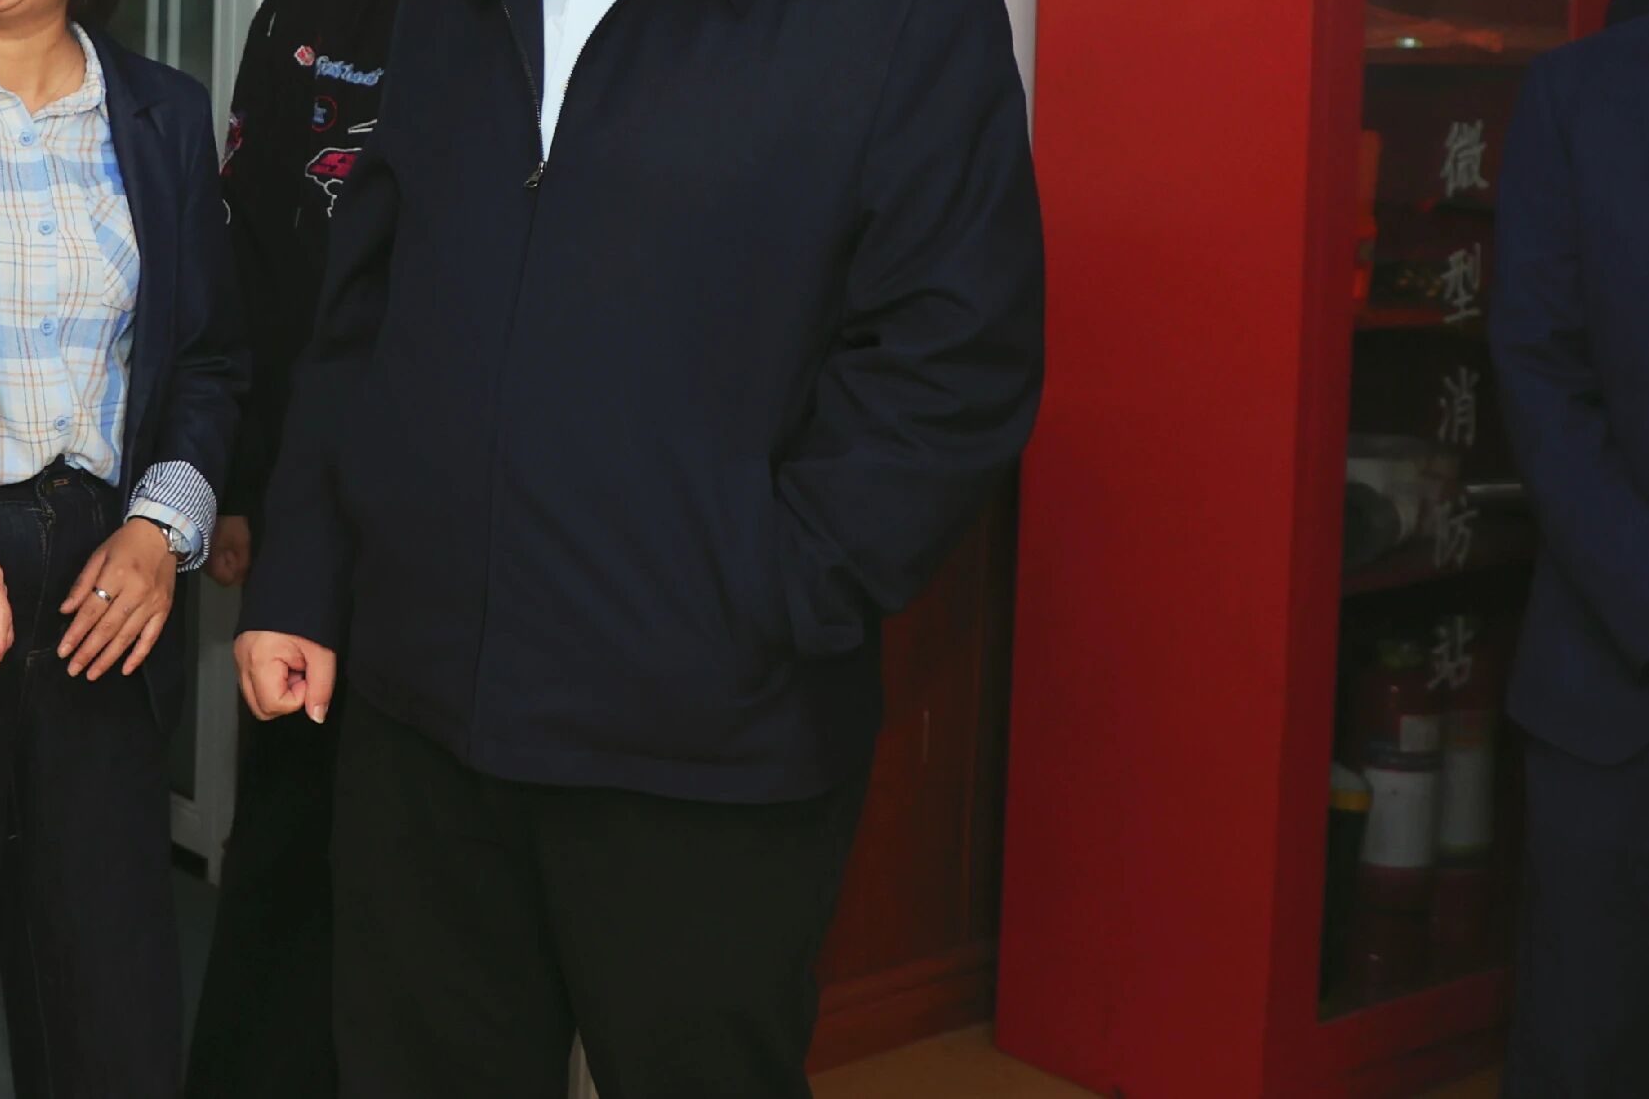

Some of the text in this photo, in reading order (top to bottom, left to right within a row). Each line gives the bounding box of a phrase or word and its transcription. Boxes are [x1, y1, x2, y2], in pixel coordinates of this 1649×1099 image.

[1427, 118, 1490, 691] 微型消防站
